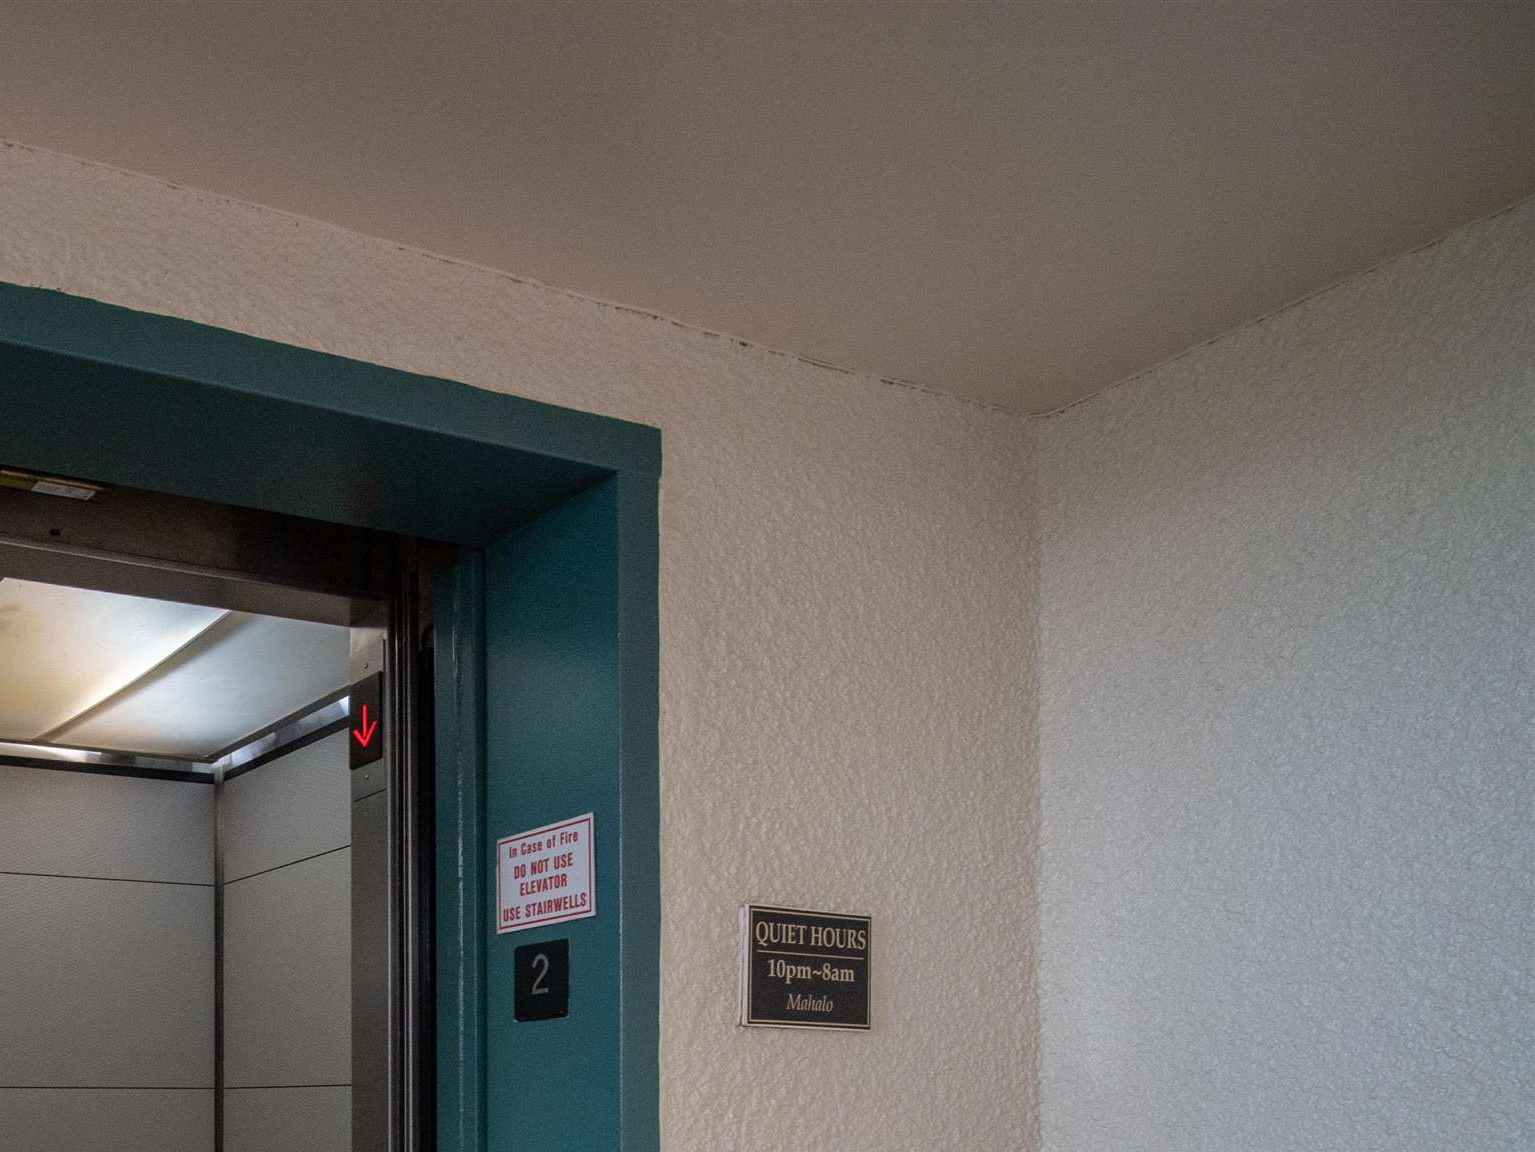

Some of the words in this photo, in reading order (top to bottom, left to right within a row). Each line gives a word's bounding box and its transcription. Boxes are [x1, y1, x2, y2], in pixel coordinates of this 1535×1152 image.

[509, 845, 517, 859] In
[521, 840, 543, 857] Case
[546, 834, 557, 849] of
[560, 830, 579, 846] Fire
[514, 864, 526, 880] DO
[530, 858, 550, 875] NOT
[554, 852, 574, 870] USE
[520, 873, 568, 897] ELEVATOR
[503, 906, 521, 922] USE
[525, 893, 587, 918] STAIRWELLS
[755, 921, 807, 946] QUIET
[810, 926, 866, 950] HOURS
[531, 953, 550, 995] 2
[786, 993, 834, 1013] Mahalo
